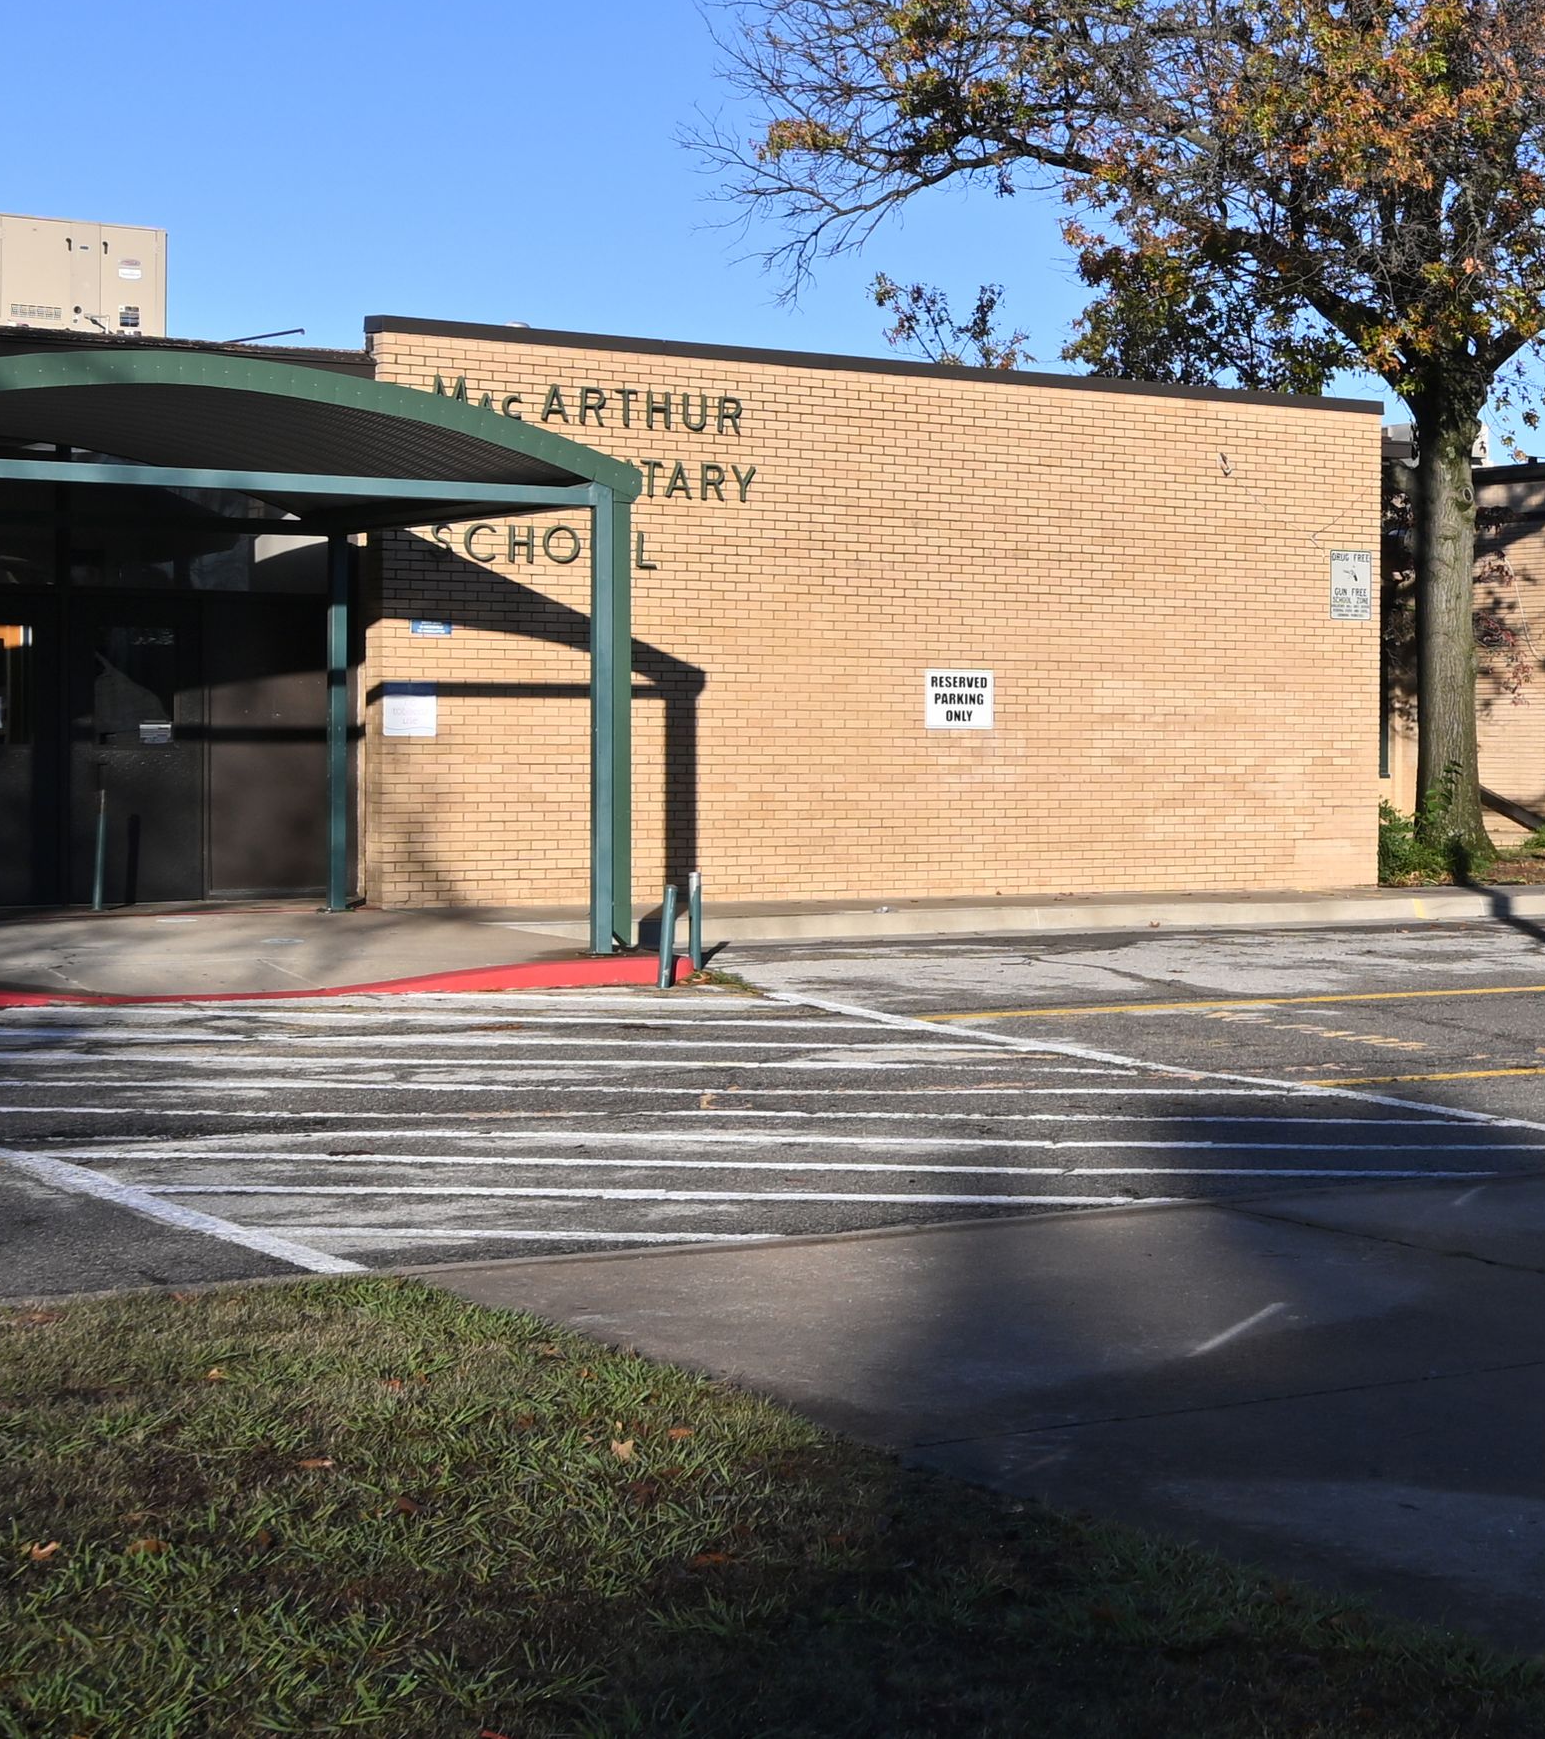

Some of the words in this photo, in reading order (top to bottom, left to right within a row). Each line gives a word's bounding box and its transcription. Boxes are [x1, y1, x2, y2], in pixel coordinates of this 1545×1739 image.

[431, 522, 657, 570] SCHOL
[1331, 552, 1350, 562] DRUG
[1353, 553, 1370, 563] FREE
[1334, 587, 1348, 596] GUN
[1351, 587, 1367, 597] FREE
[931, 676, 988, 688] RESERVED
[934, 693, 984, 705] PARKING
[945, 710, 973, 722] ONLY
